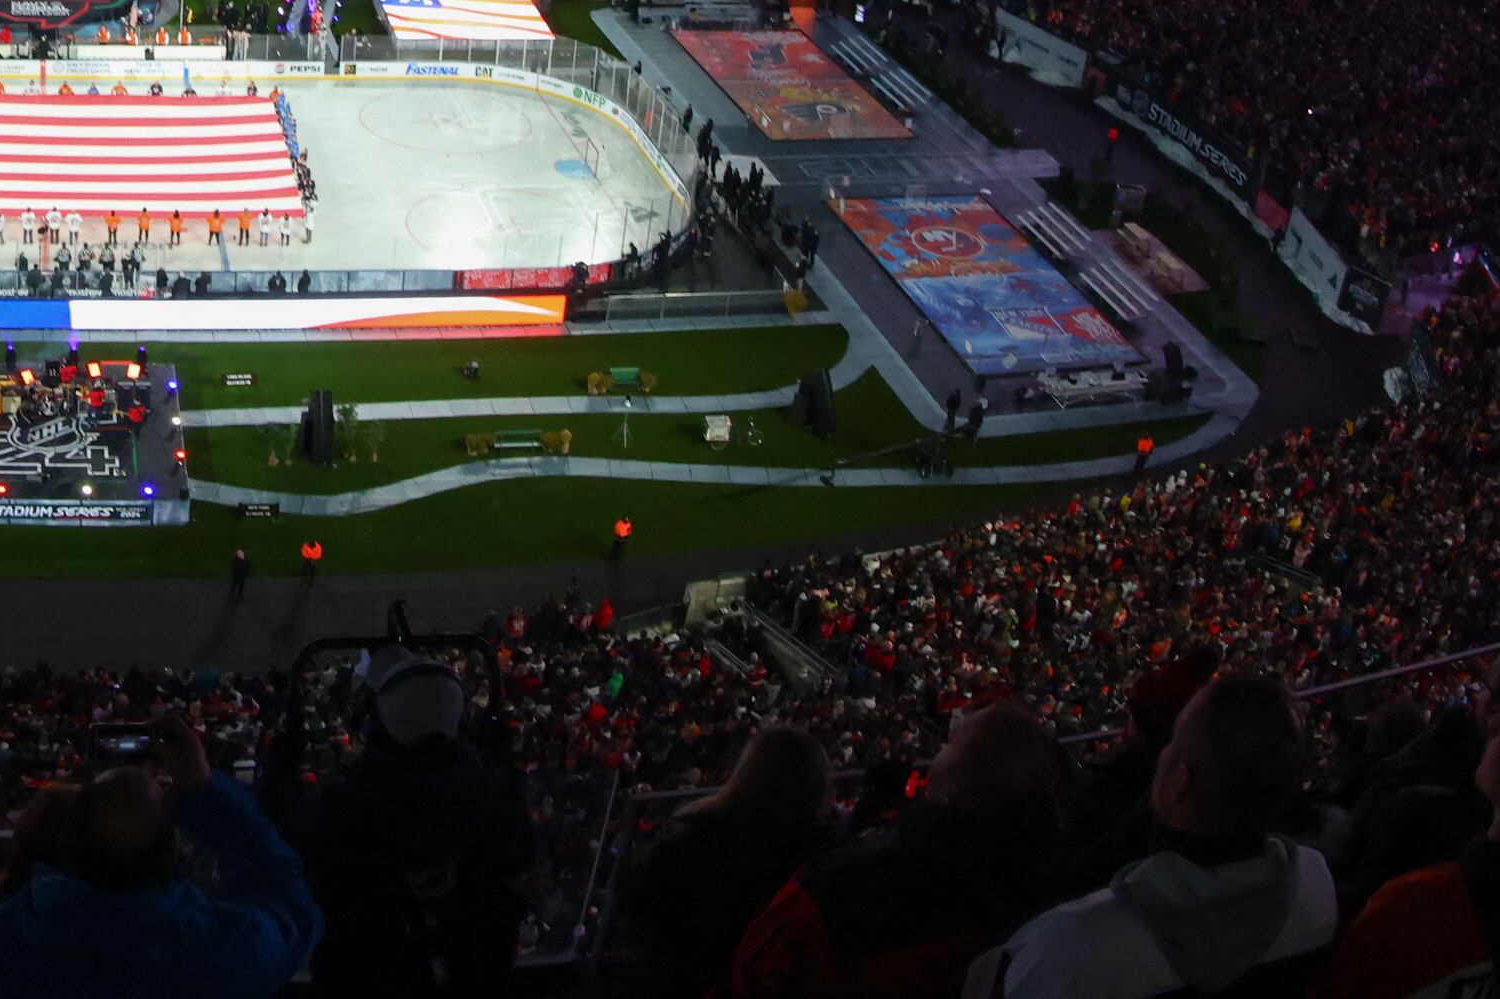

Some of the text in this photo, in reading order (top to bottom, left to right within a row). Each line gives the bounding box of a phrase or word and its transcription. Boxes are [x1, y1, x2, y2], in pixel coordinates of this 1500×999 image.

[290, 65, 321, 73] PEPSI
[475, 66, 494, 77] CAT
[584, 91, 607, 109] NFP
[1148, 103, 1248, 187] STADIUM SERIES
[28, 421, 71, 443] NHL
[52, 506, 114, 518] SERIES
